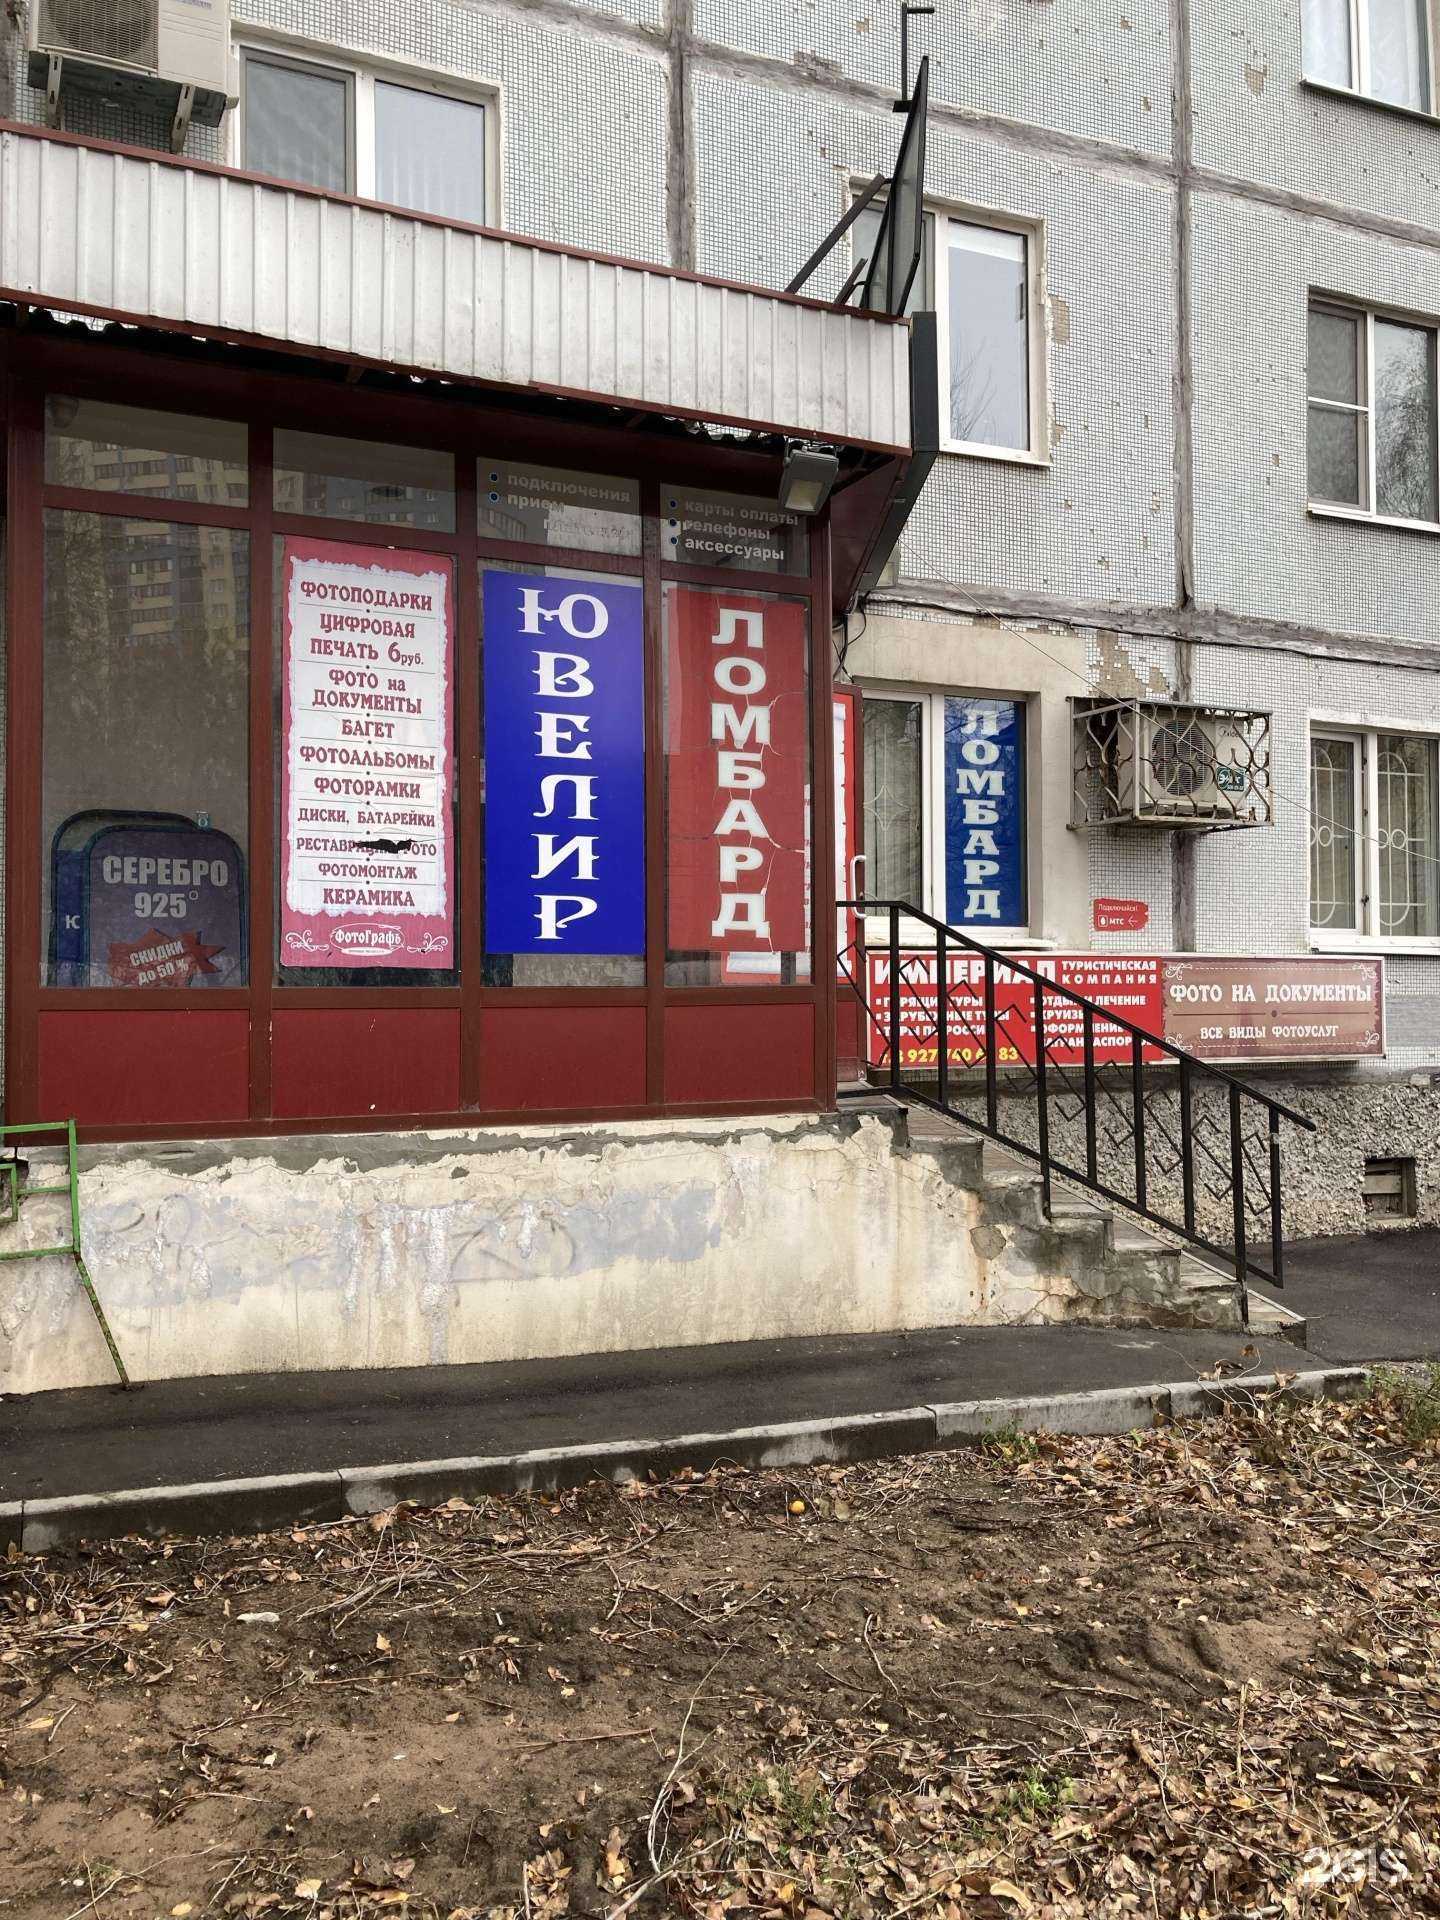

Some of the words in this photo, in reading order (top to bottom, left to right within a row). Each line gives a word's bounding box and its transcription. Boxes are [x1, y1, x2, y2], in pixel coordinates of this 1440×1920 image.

[507, 475, 631, 502] подключения
[507, 494, 565, 513] прием
[685, 501, 735, 517] карты
[740, 508, 799, 526] оплаты
[685, 538, 785, 561] аксессуары
[300, 581, 433, 611] ФОТОПОДАРКИ
[319, 613, 416, 639] ЦИФРОВАЯ
[310, 638, 379, 660] ПЕЧАТЬ
[328, 669, 379, 689] ФОТО
[387, 679, 407, 692] на
[311, 689, 422, 714] ДОКУМЕНТЫ
[341, 719, 395, 739] БАГЕТ
[300, 745, 436, 770] ФОТОАЛЬБОМЫ
[517, 587, 609, 941] ЮВЕЛИР
[711, 607, 772, 939] ЛОМБАРД
[314, 777, 421, 799] ФОТОРАМКИ
[297, 808, 350, 824] ДИСКИ,
[357, 810, 435, 827] БАТАРЕЙКИ
[955, 709, 1006, 919] ЛОМБАРД
[296, 837, 396, 857] РЕСТАВР
[402, 842, 437, 856] ОТО
[102, 855, 229, 887] СЕРЕБРО
[318, 863, 418, 880] ФОТОМОНТАЖ
[323, 888, 415, 907] КЕРАМИКА
[1109, 917, 1125, 926] МТС
[129, 940, 185, 967] СКИДКИ
[1062, 960, 1157, 971] ТУРИСТИЧЕСКАЯ
[1062, 974, 1157, 985] КОМПАНИЯ
[883, 996, 940, 1009] ГРЯЩИ
[1095, 995, 1147, 1006] ЛЕЧЕНИЕ
[1169, 984, 1223, 1003] ФОТО
[1231, 984, 1256, 1002] НА
[1264, 984, 1372, 1004] ДОКУМЕНТЫ
[883, 1025, 920, 1037] ТРЫ
[945, 1025, 989, 1037] РОССИ
[1200, 1027, 1223, 1039] ВСЕ
[1228, 1026, 1266, 1039] ВИДЫ
[1271, 1025, 1339, 1038] ФОТОУСЛУГ
[907, 1048, 938, 1063] 927
[998, 1046, 1018, 1061] 83
